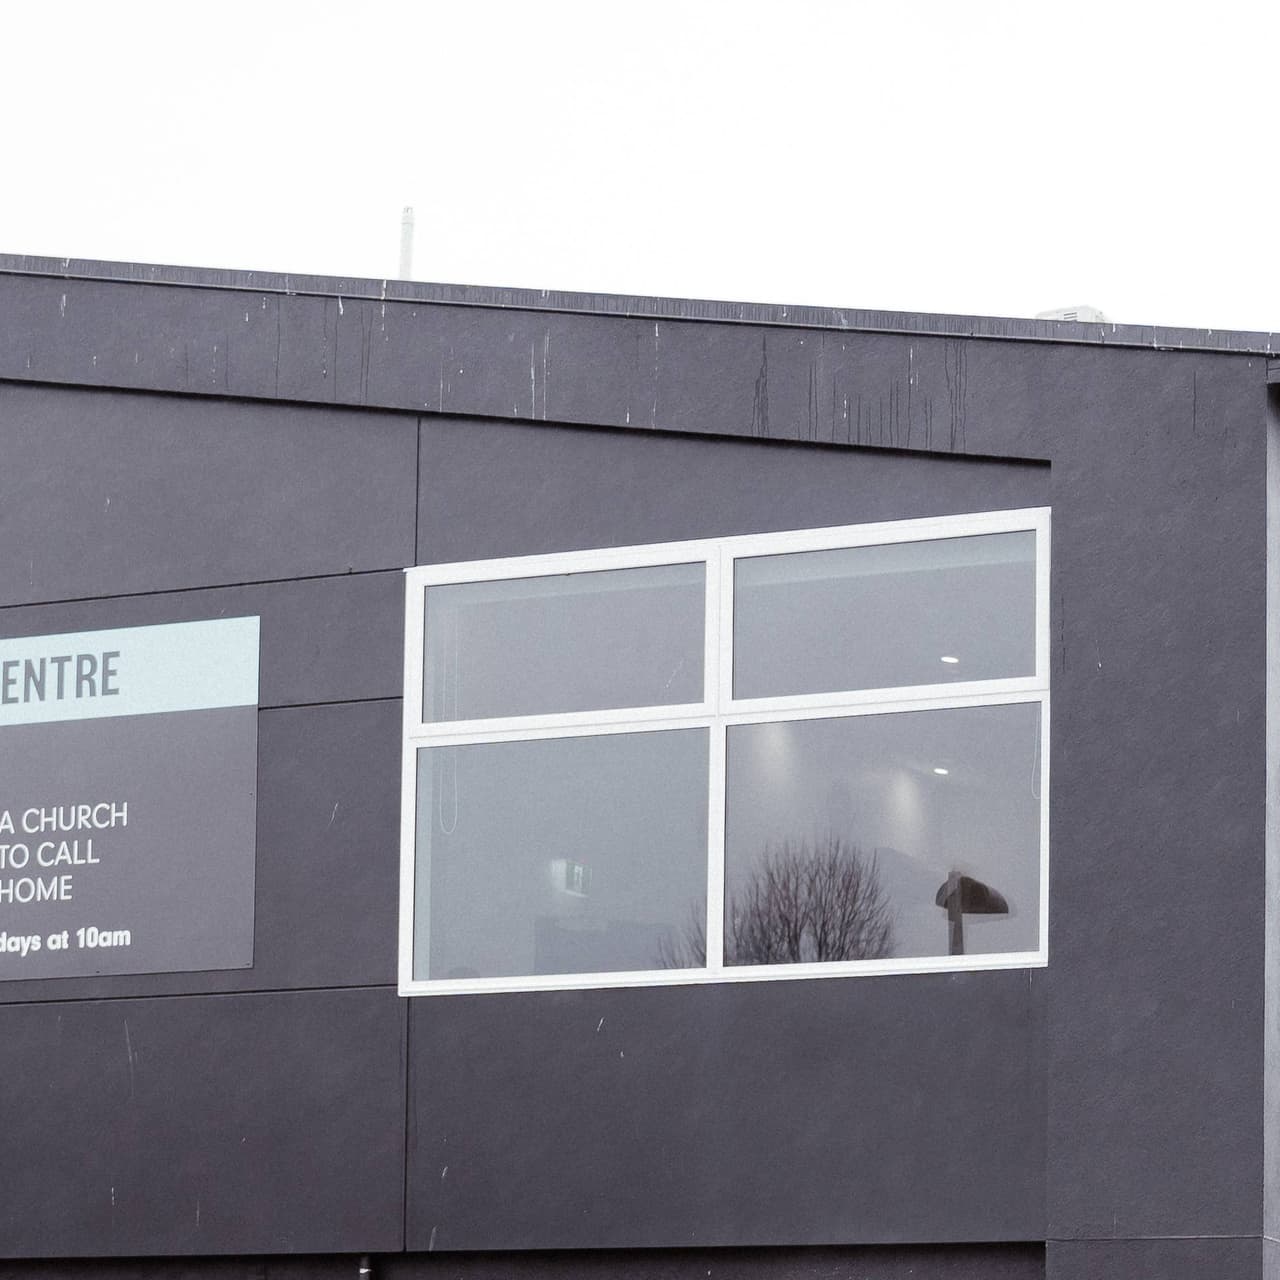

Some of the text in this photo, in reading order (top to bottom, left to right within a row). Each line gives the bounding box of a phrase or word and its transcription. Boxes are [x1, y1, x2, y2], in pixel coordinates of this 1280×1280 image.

[22, 801, 128, 833] CHURCH
[37, 839, 100, 867] CALL
[47, 930, 70, 950] at
[76, 926, 131, 949] 10am
